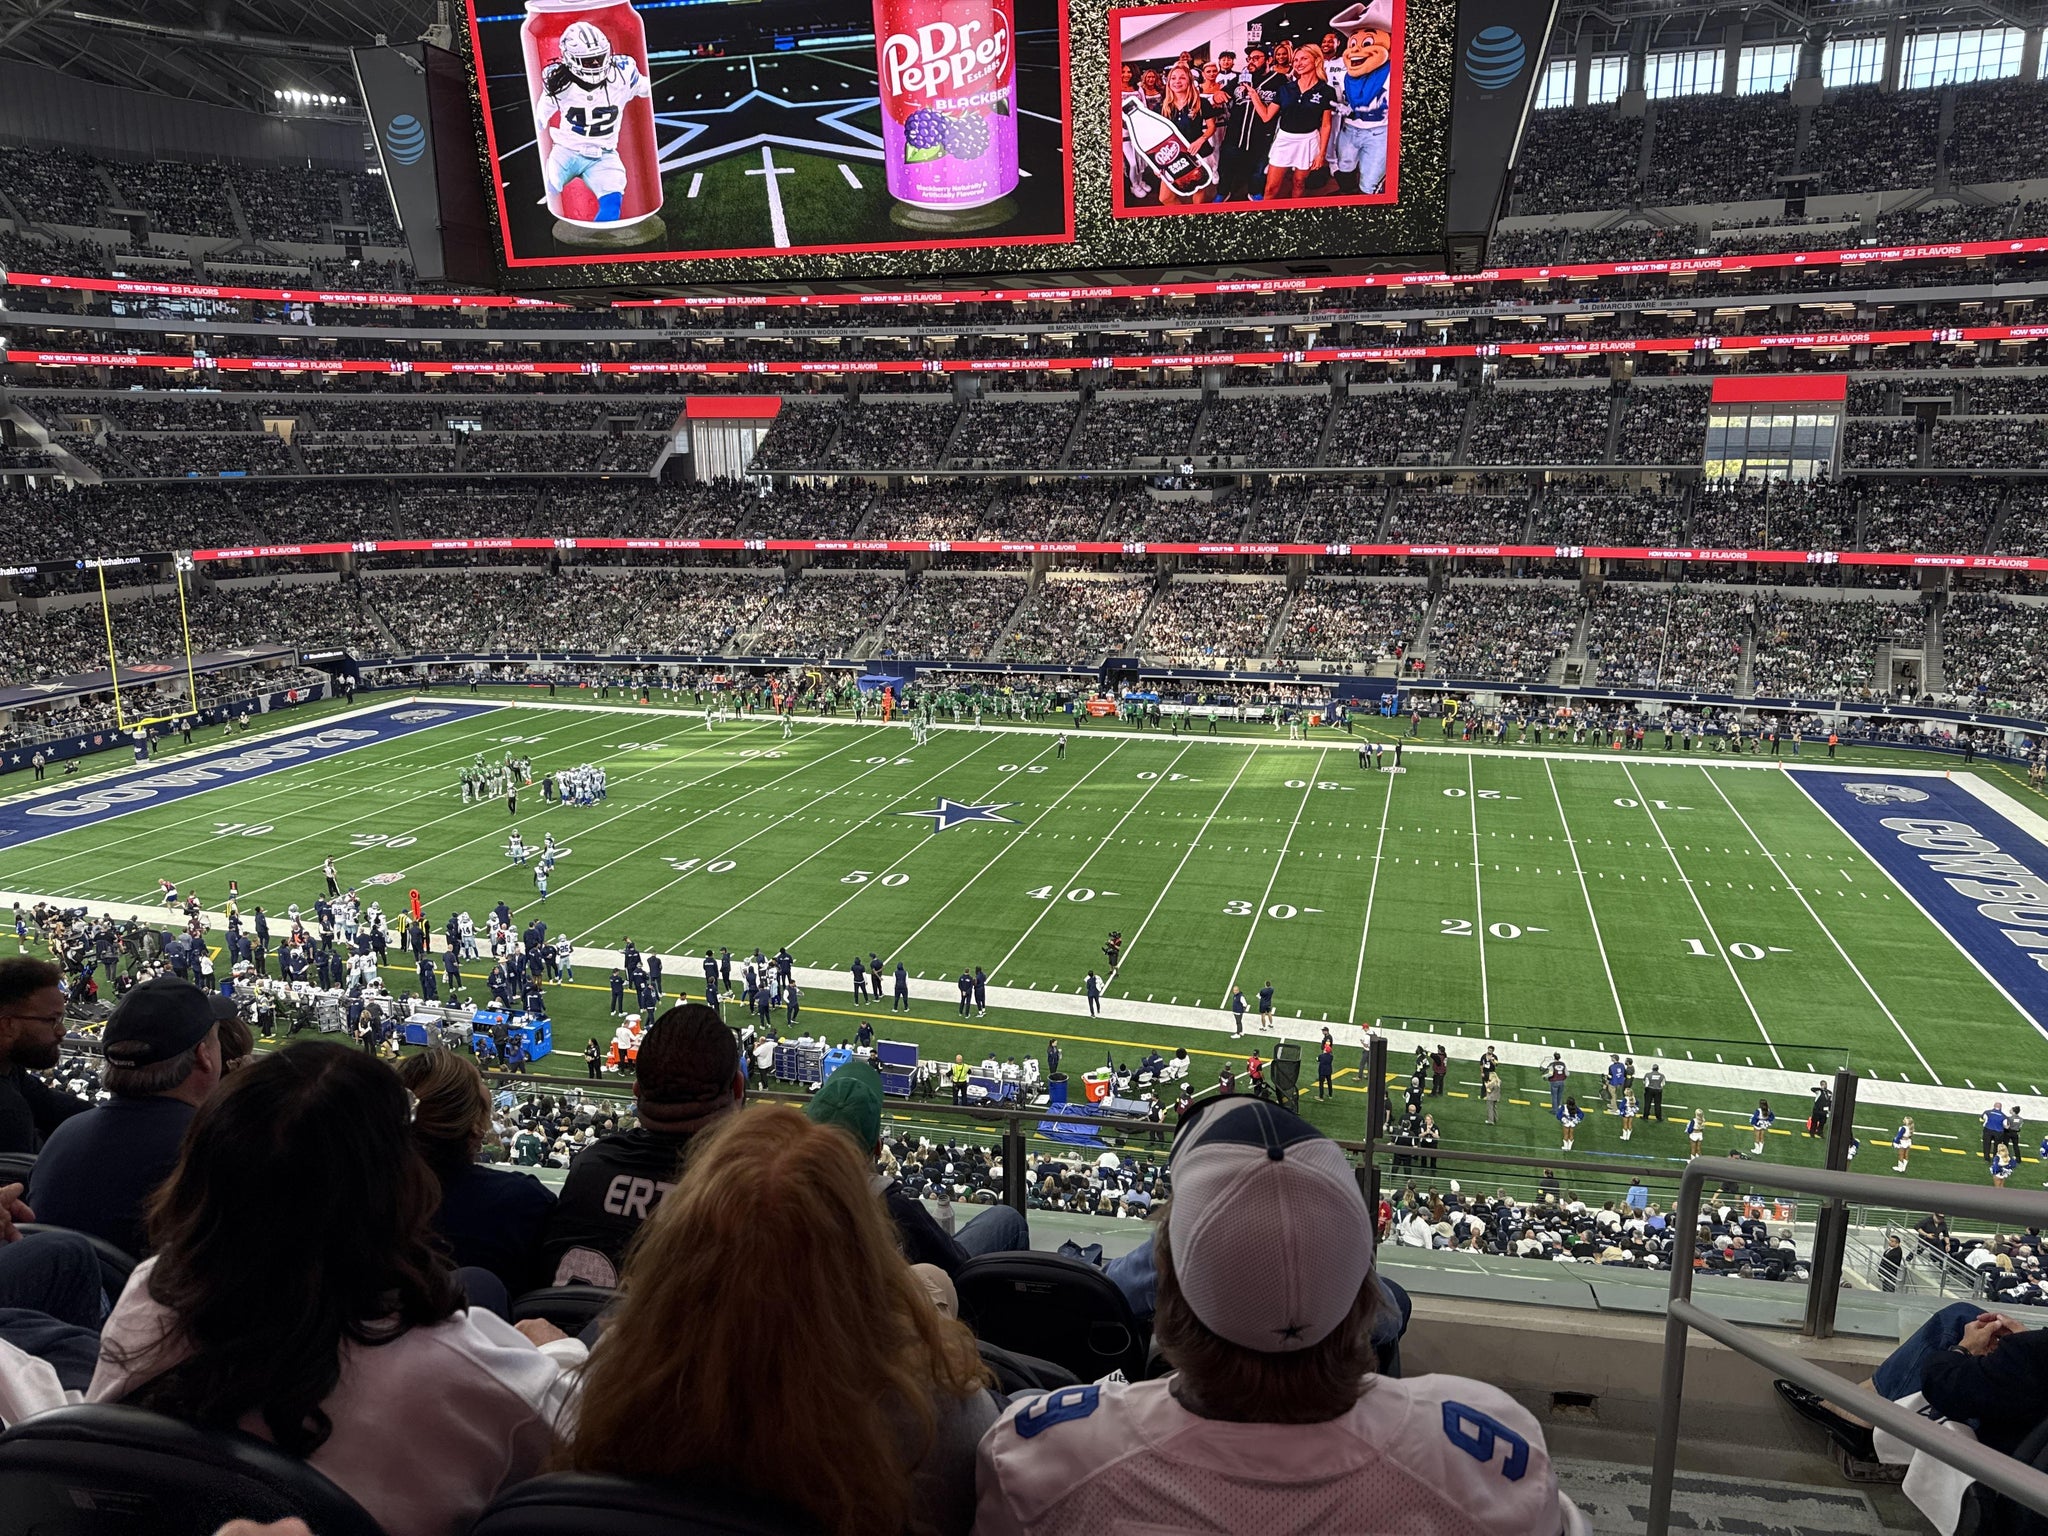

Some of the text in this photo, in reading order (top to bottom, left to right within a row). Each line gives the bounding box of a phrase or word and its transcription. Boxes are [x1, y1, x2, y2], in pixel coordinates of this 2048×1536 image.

[1251, 23, 1262, 31] 205
[918, 20, 981, 64] Dr
[883, 28, 1007, 98] Pepper
[565, 106, 619, 137] 42
[952, 182, 981, 191] Naturally
[1917, 247, 1961, 255] FLAVORS
[1683, 260, 1722, 268] FLAVORS
[184, 287, 219, 295] FLAVORS
[1263, 282, 1273, 291] 23
[91, 356, 101, 364] 23
[102, 356, 137, 364] FLAVORS
[0, 566, 37, 577] hain.com
[25, 728, 379, 817] COWBOYS
[210, 823, 274, 836] 10
[351, 834, 417, 848] 20
[671, 857, 737, 874] 40
[840, 869, 911, 888] 50
[1025, 884, 1096, 902] 40
[1880, 817, 2048, 972] COWBO
[1222, 900, 1298, 920] 30
[1440, 918, 1522, 939] 20
[1681, 938, 1767, 961] 10
[1030, 1062, 1037, 1073] 5
[1094, 1085, 1105, 1096] G
[522, 1146, 527, 1156] 1
